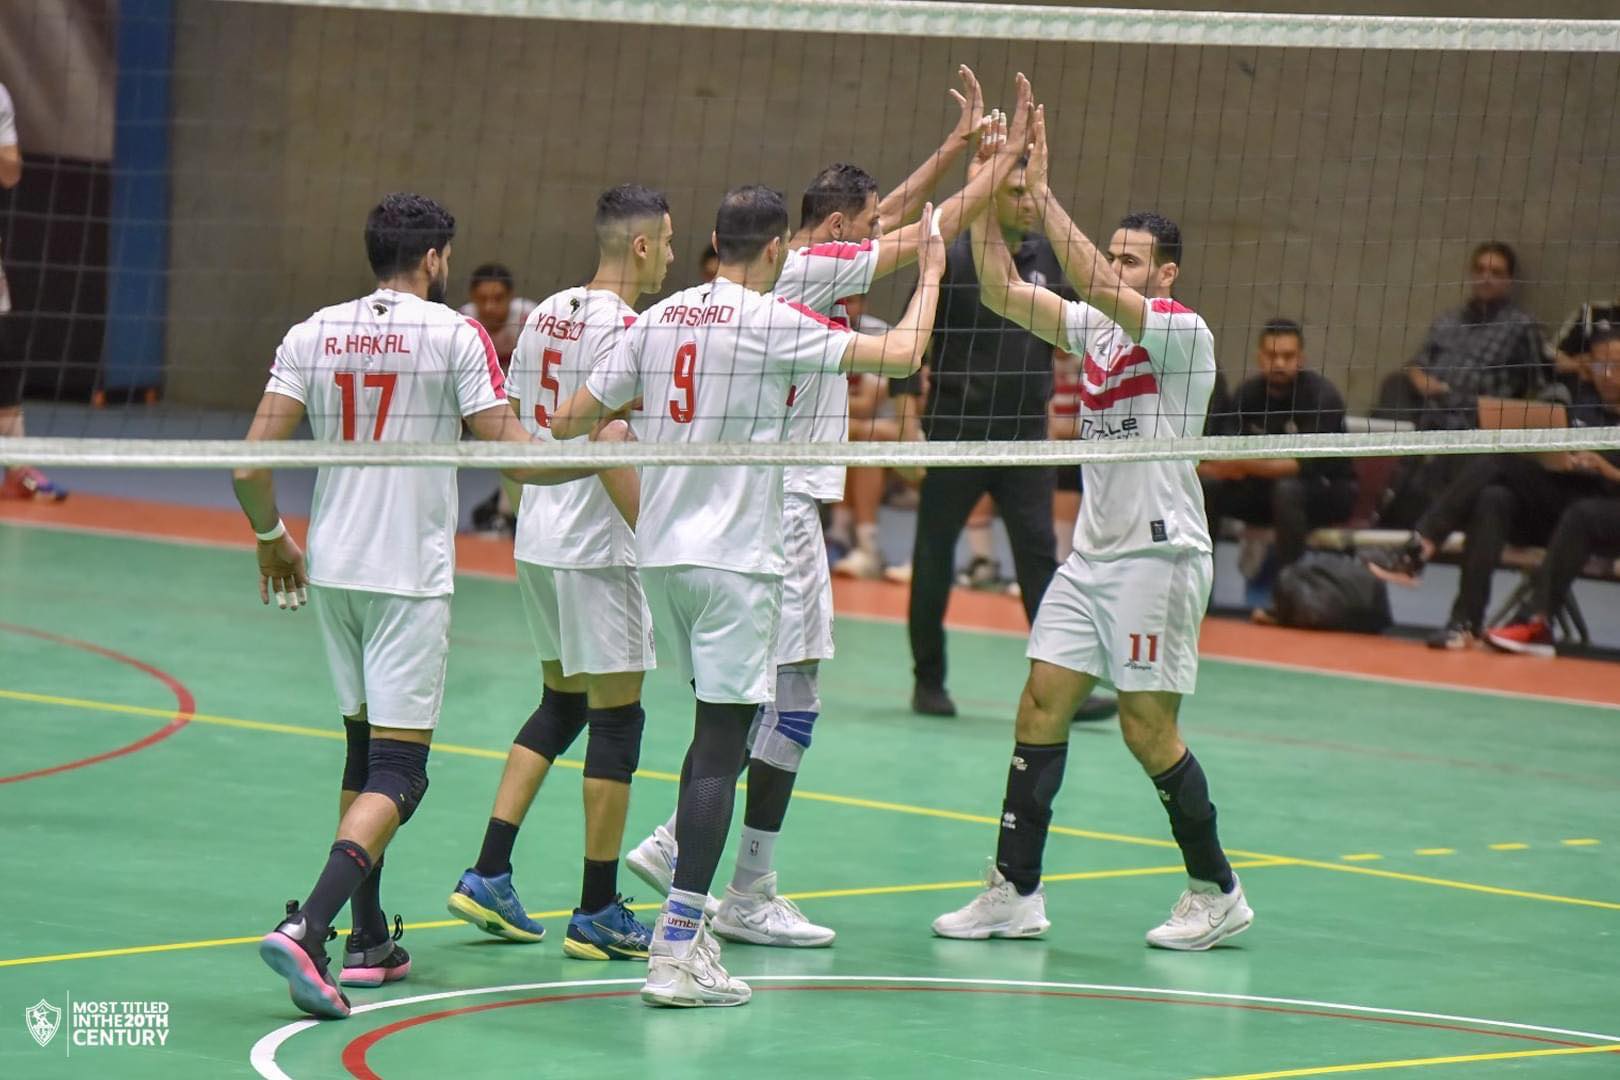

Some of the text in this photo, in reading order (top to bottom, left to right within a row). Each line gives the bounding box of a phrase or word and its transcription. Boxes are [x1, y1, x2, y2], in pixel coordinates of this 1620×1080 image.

[333, 370, 398, 442] 17
[534, 346, 563, 429] 5
[669, 342, 697, 424] 9
[1129, 633, 1158, 663] 11
